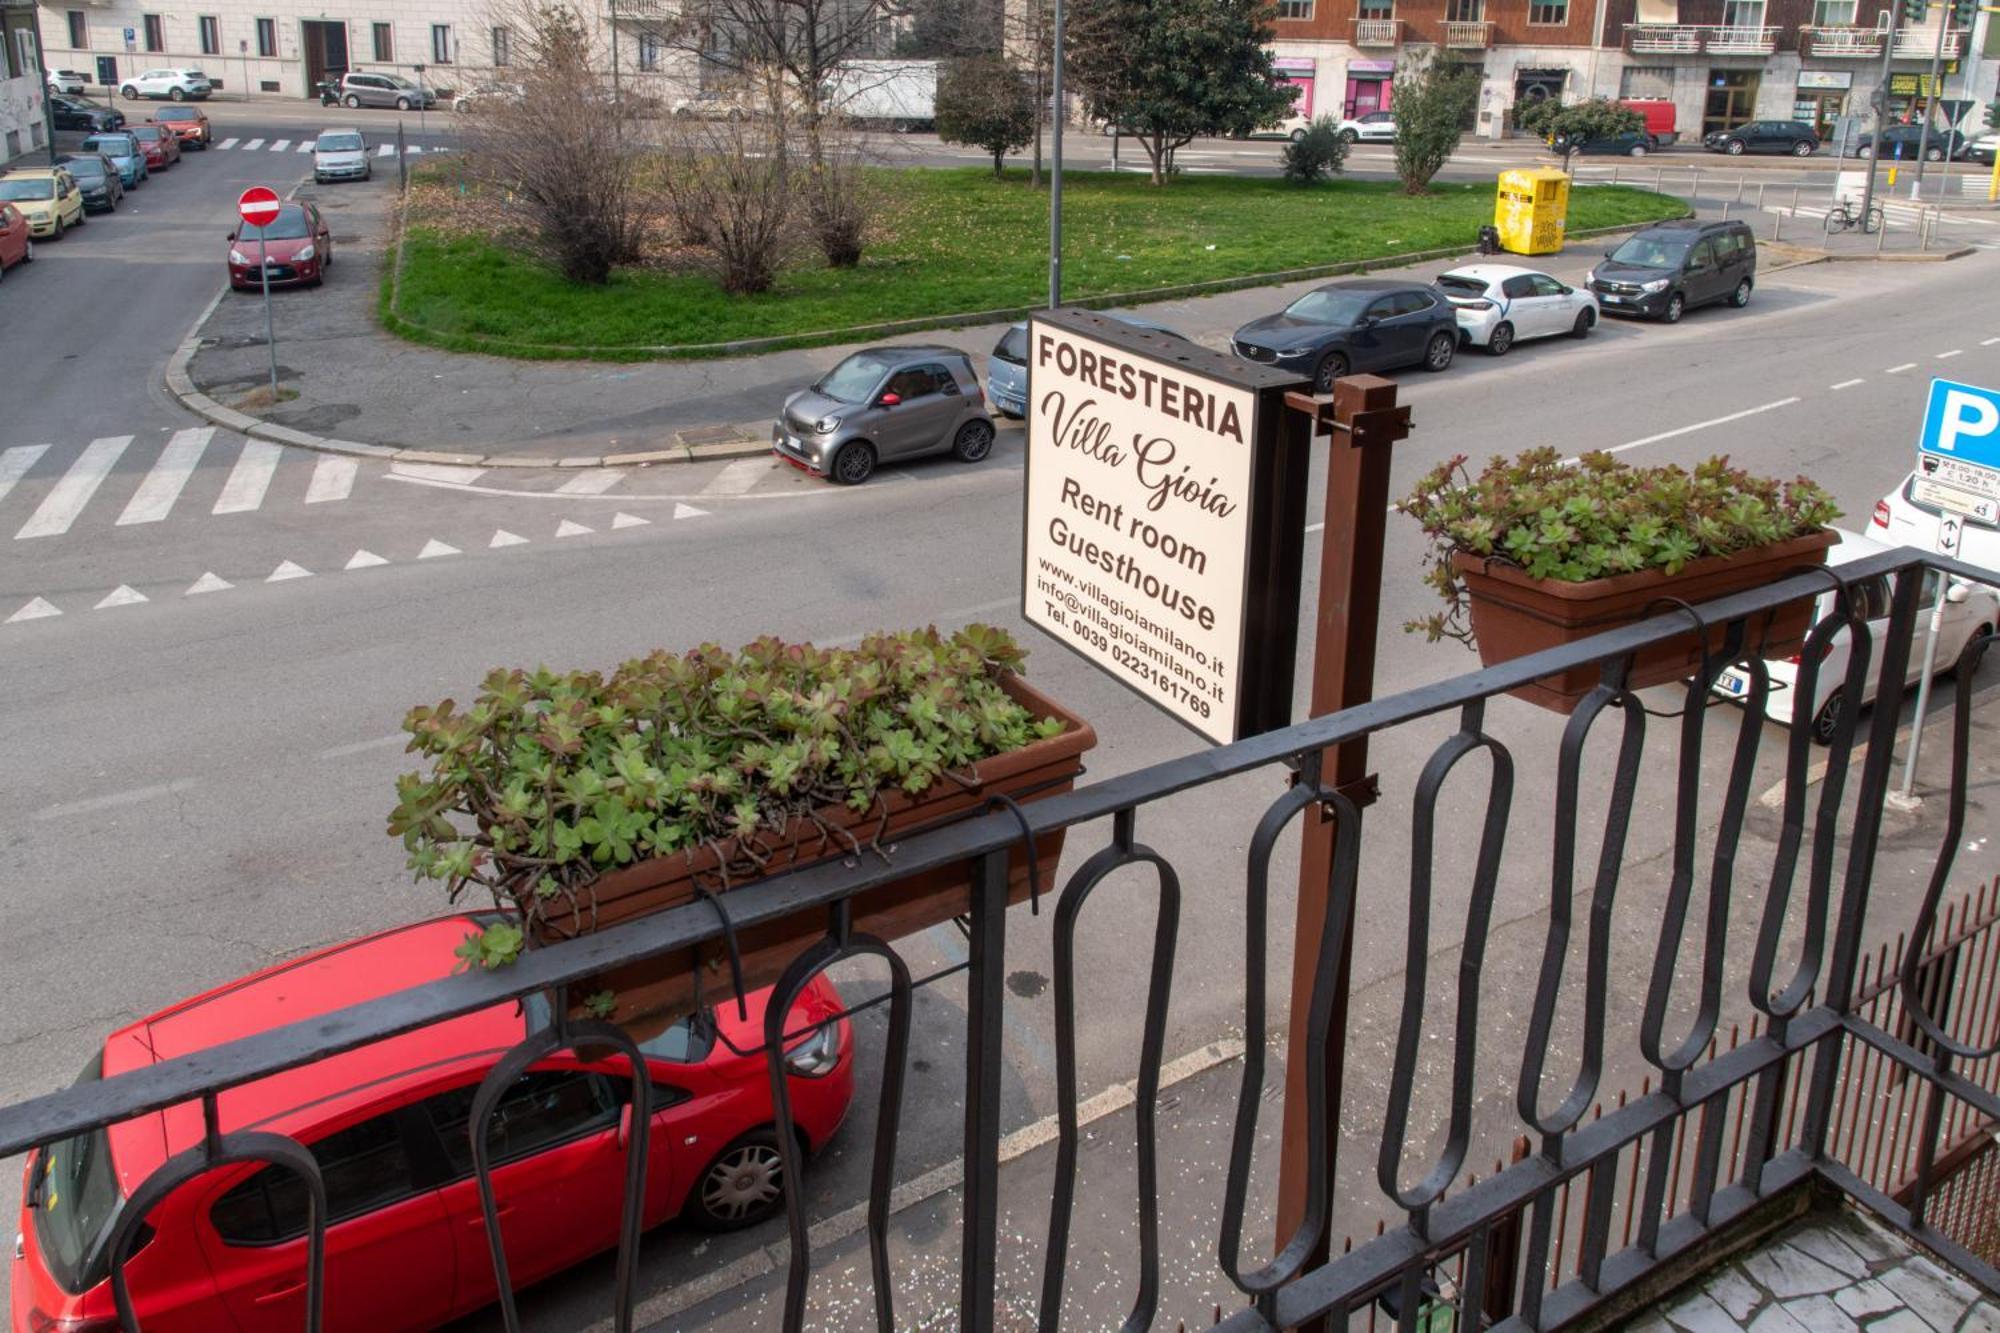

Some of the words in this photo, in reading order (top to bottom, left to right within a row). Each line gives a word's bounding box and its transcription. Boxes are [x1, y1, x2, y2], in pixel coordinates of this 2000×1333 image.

[1039, 334, 1244, 445] FORESTERIA
[1938, 389, 2000, 451] P
[1041, 391, 1128, 468] Villa
[1132, 433, 1237, 519] Gioia
[1049, 517, 1216, 632] Guesthouse
[1060, 476, 1124, 532] Rent
[1129, 517, 1208, 576] room
[1037, 575, 1225, 704] info@villagioiamilano.it
[1038, 556, 1225, 678] www.villagioiamilano.it
[1045, 600, 1069, 629] Tel.
[1073, 619, 1109, 652] 0039
[1112, 643, 1212, 719] 0223161769
